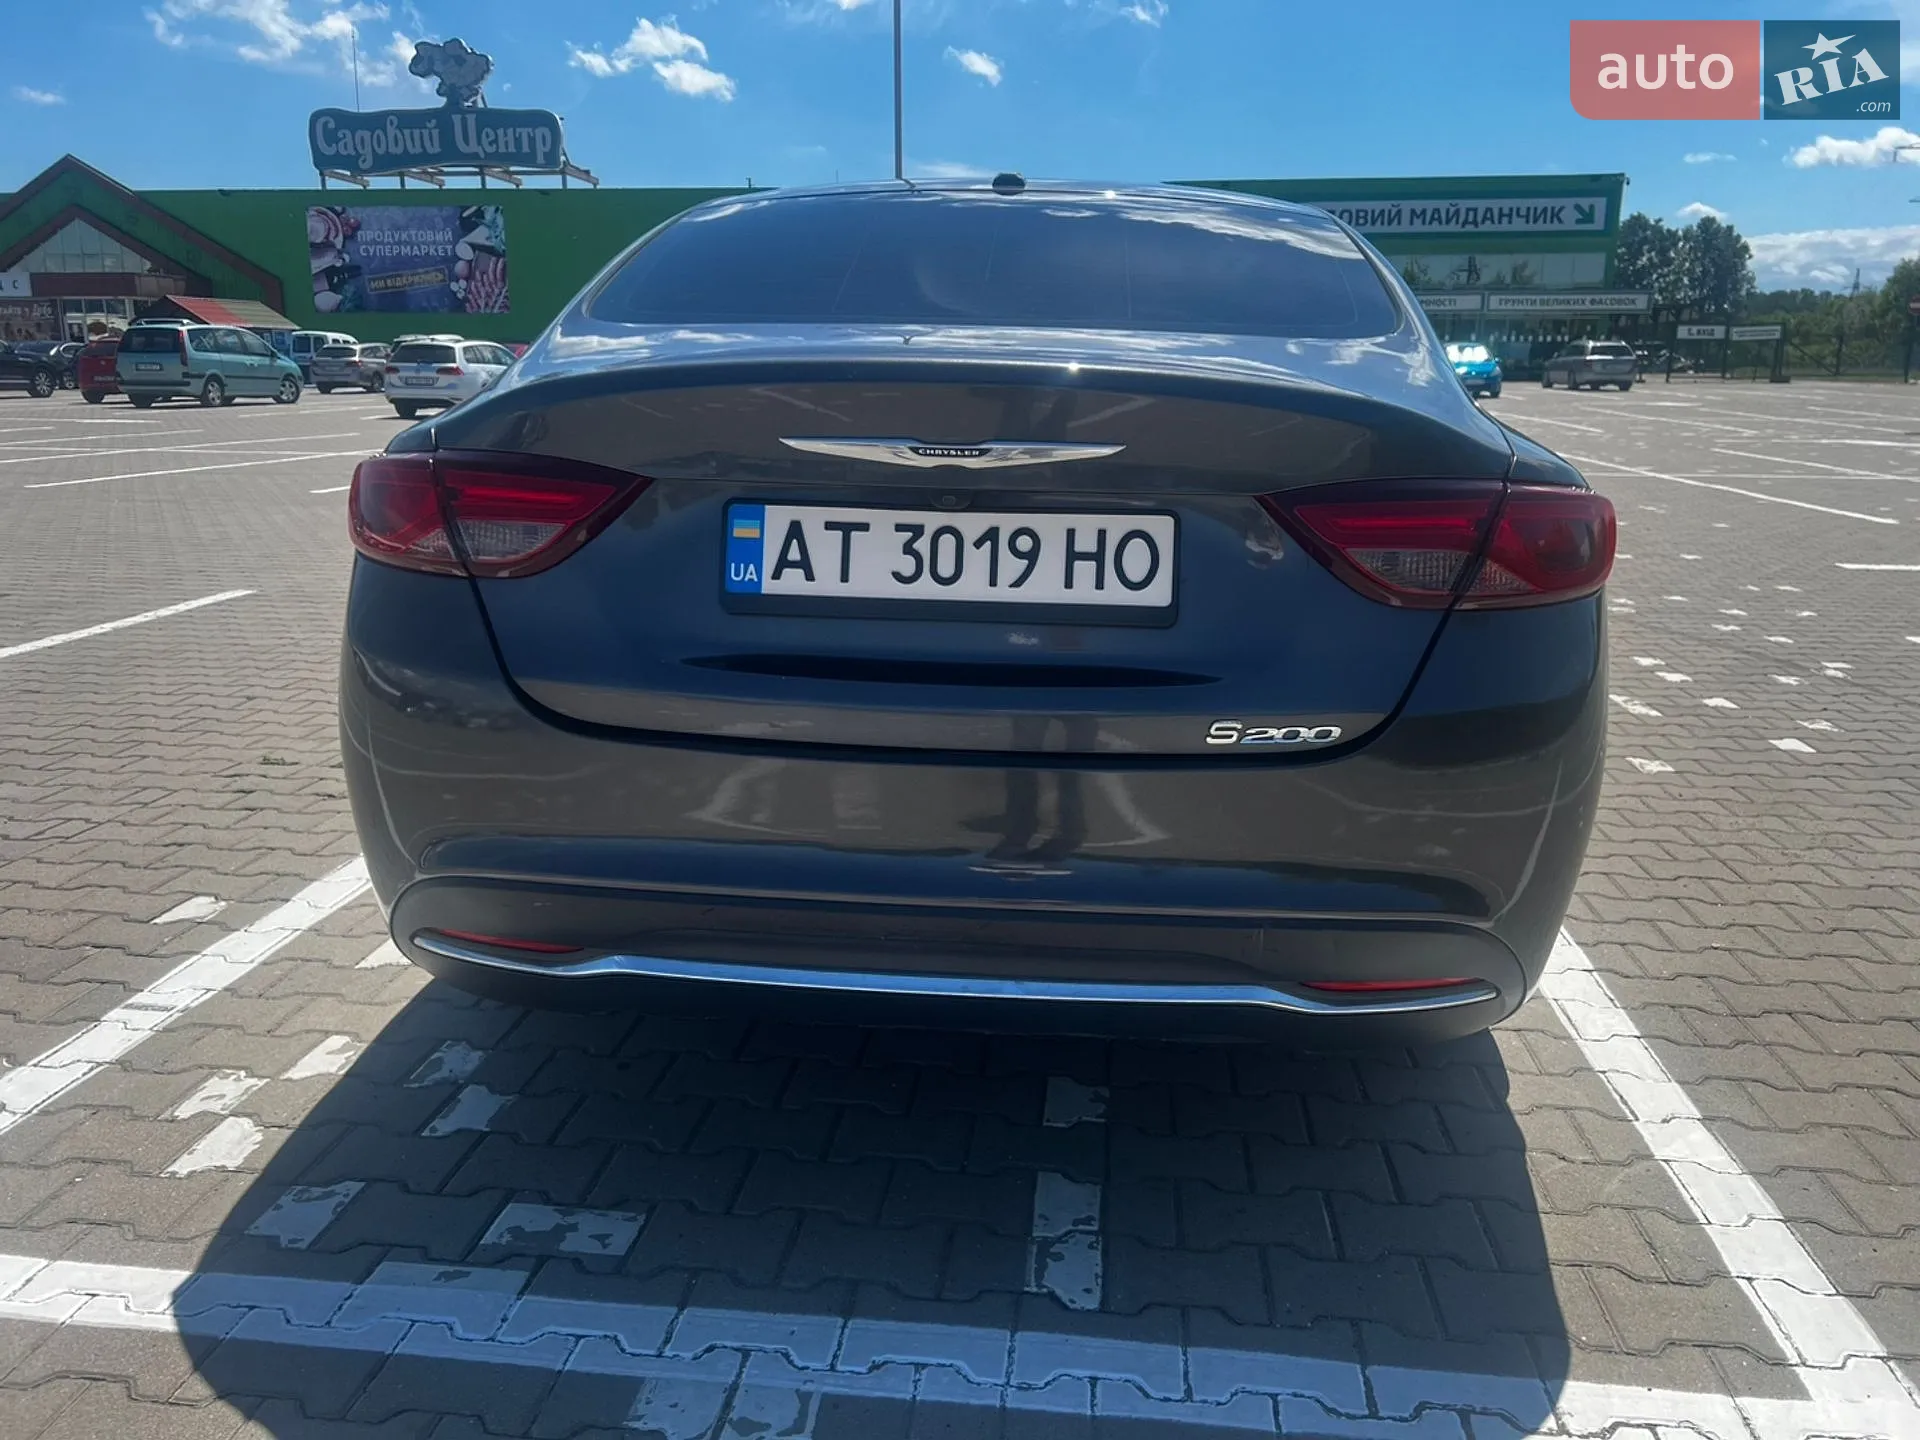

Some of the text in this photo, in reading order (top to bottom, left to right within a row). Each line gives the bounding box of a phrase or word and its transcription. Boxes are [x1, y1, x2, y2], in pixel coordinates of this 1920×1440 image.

[316, 114, 551, 169] Садовий Центр
[1409, 203, 1566, 229] МАЙДАНЧИК
[357, 227, 453, 243] ПРОДУКТОВИЙ
[359, 245, 454, 257] СУПЕРМАРКЕТ
[918, 448, 980, 456] CHRYSLER
[771, 519, 1160, 592] AT 3019 HO
[730, 562, 758, 582] UA
